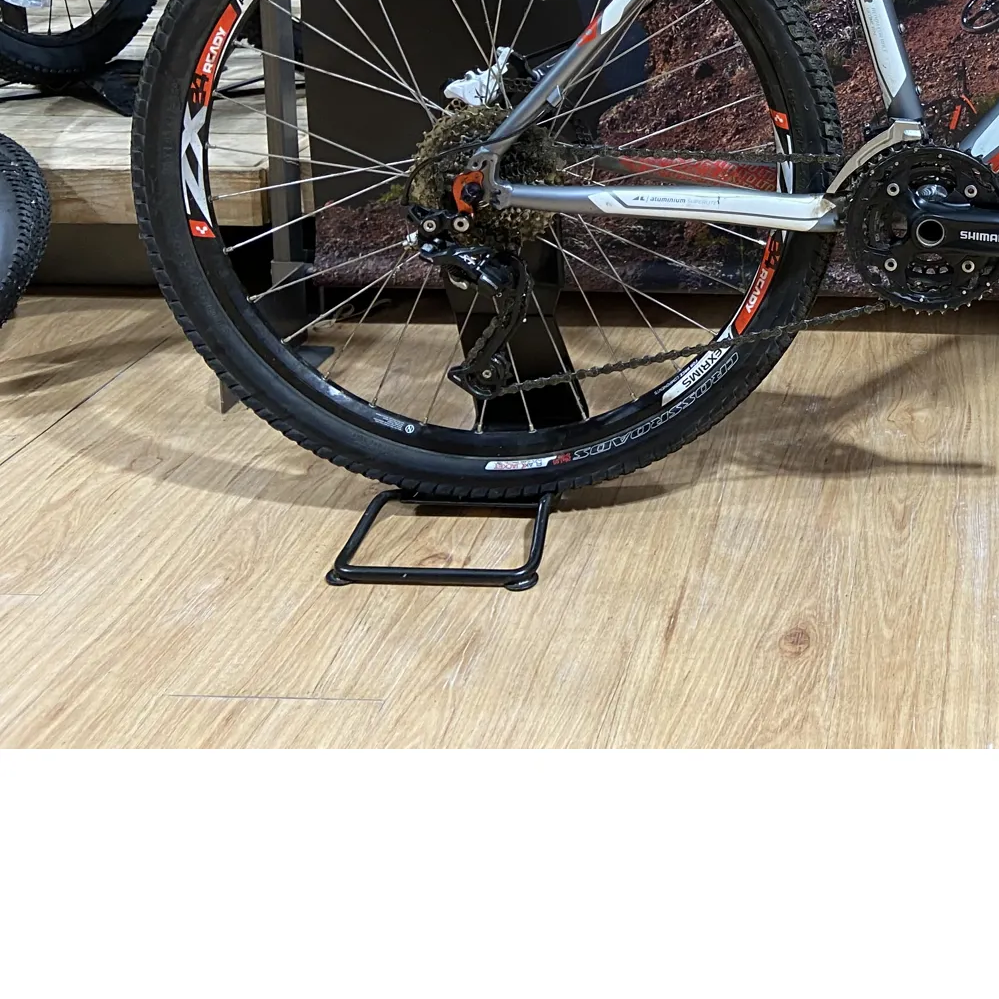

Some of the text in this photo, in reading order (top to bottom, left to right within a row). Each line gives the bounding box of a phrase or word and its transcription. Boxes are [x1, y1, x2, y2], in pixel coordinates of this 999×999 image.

[203, 26, 226, 74] READY
[649, 196, 686, 204] aluminium
[745, 269, 768, 314] READY
